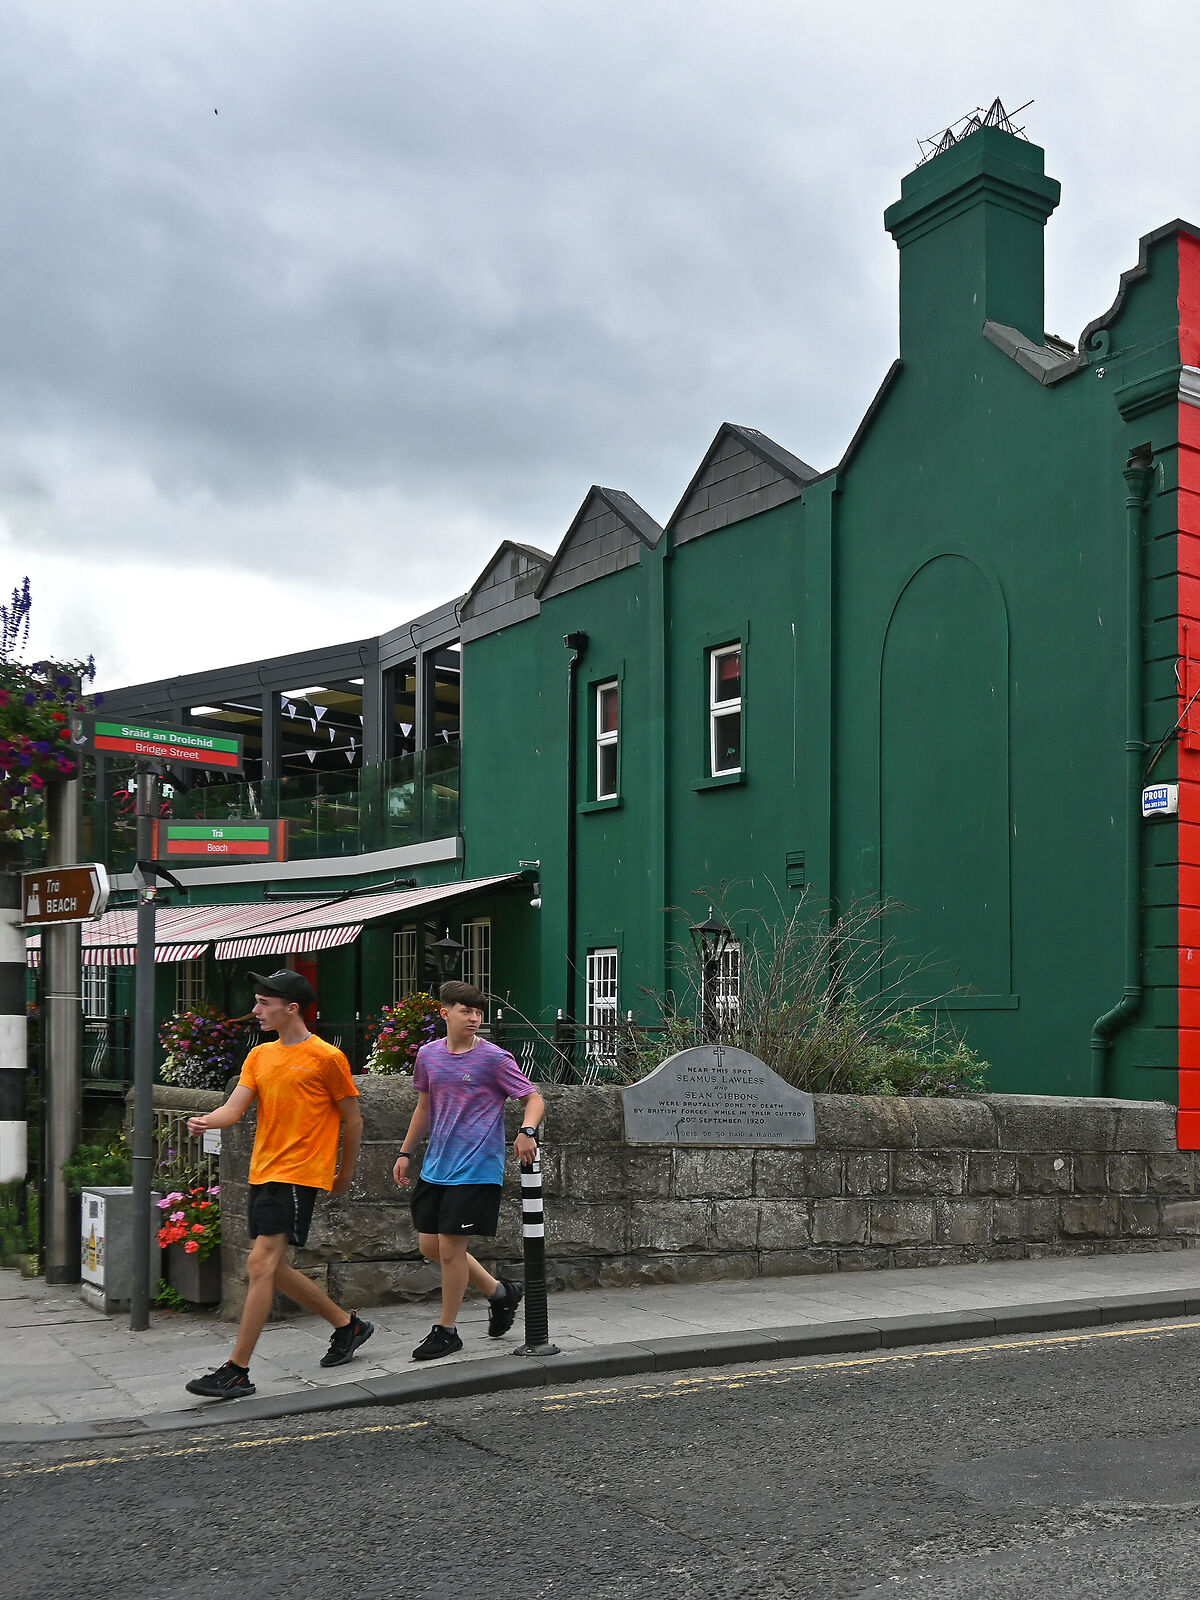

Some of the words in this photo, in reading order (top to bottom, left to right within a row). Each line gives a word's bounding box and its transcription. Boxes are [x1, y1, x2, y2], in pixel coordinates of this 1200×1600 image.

[121, 727, 150, 739] Sráid
[152, 732, 166, 741] an
[169, 734, 213, 748] Droichid
[135, 742, 167, 756] Bridge
[169, 747, 200, 760] Street
[1144, 789, 1168, 801] PROUT
[211, 828, 223, 838] Trá
[207, 843, 228, 852] Beach
[46, 879, 60, 893] Trá
[46, 897, 77, 914] BEACH
[676, 1074, 717, 1083] SEAMUS
[722, 1076, 765, 1085] LAWLESS
[685, 1091, 713, 1099] SEAN
[717, 1092, 759, 1101] GIBBONS
